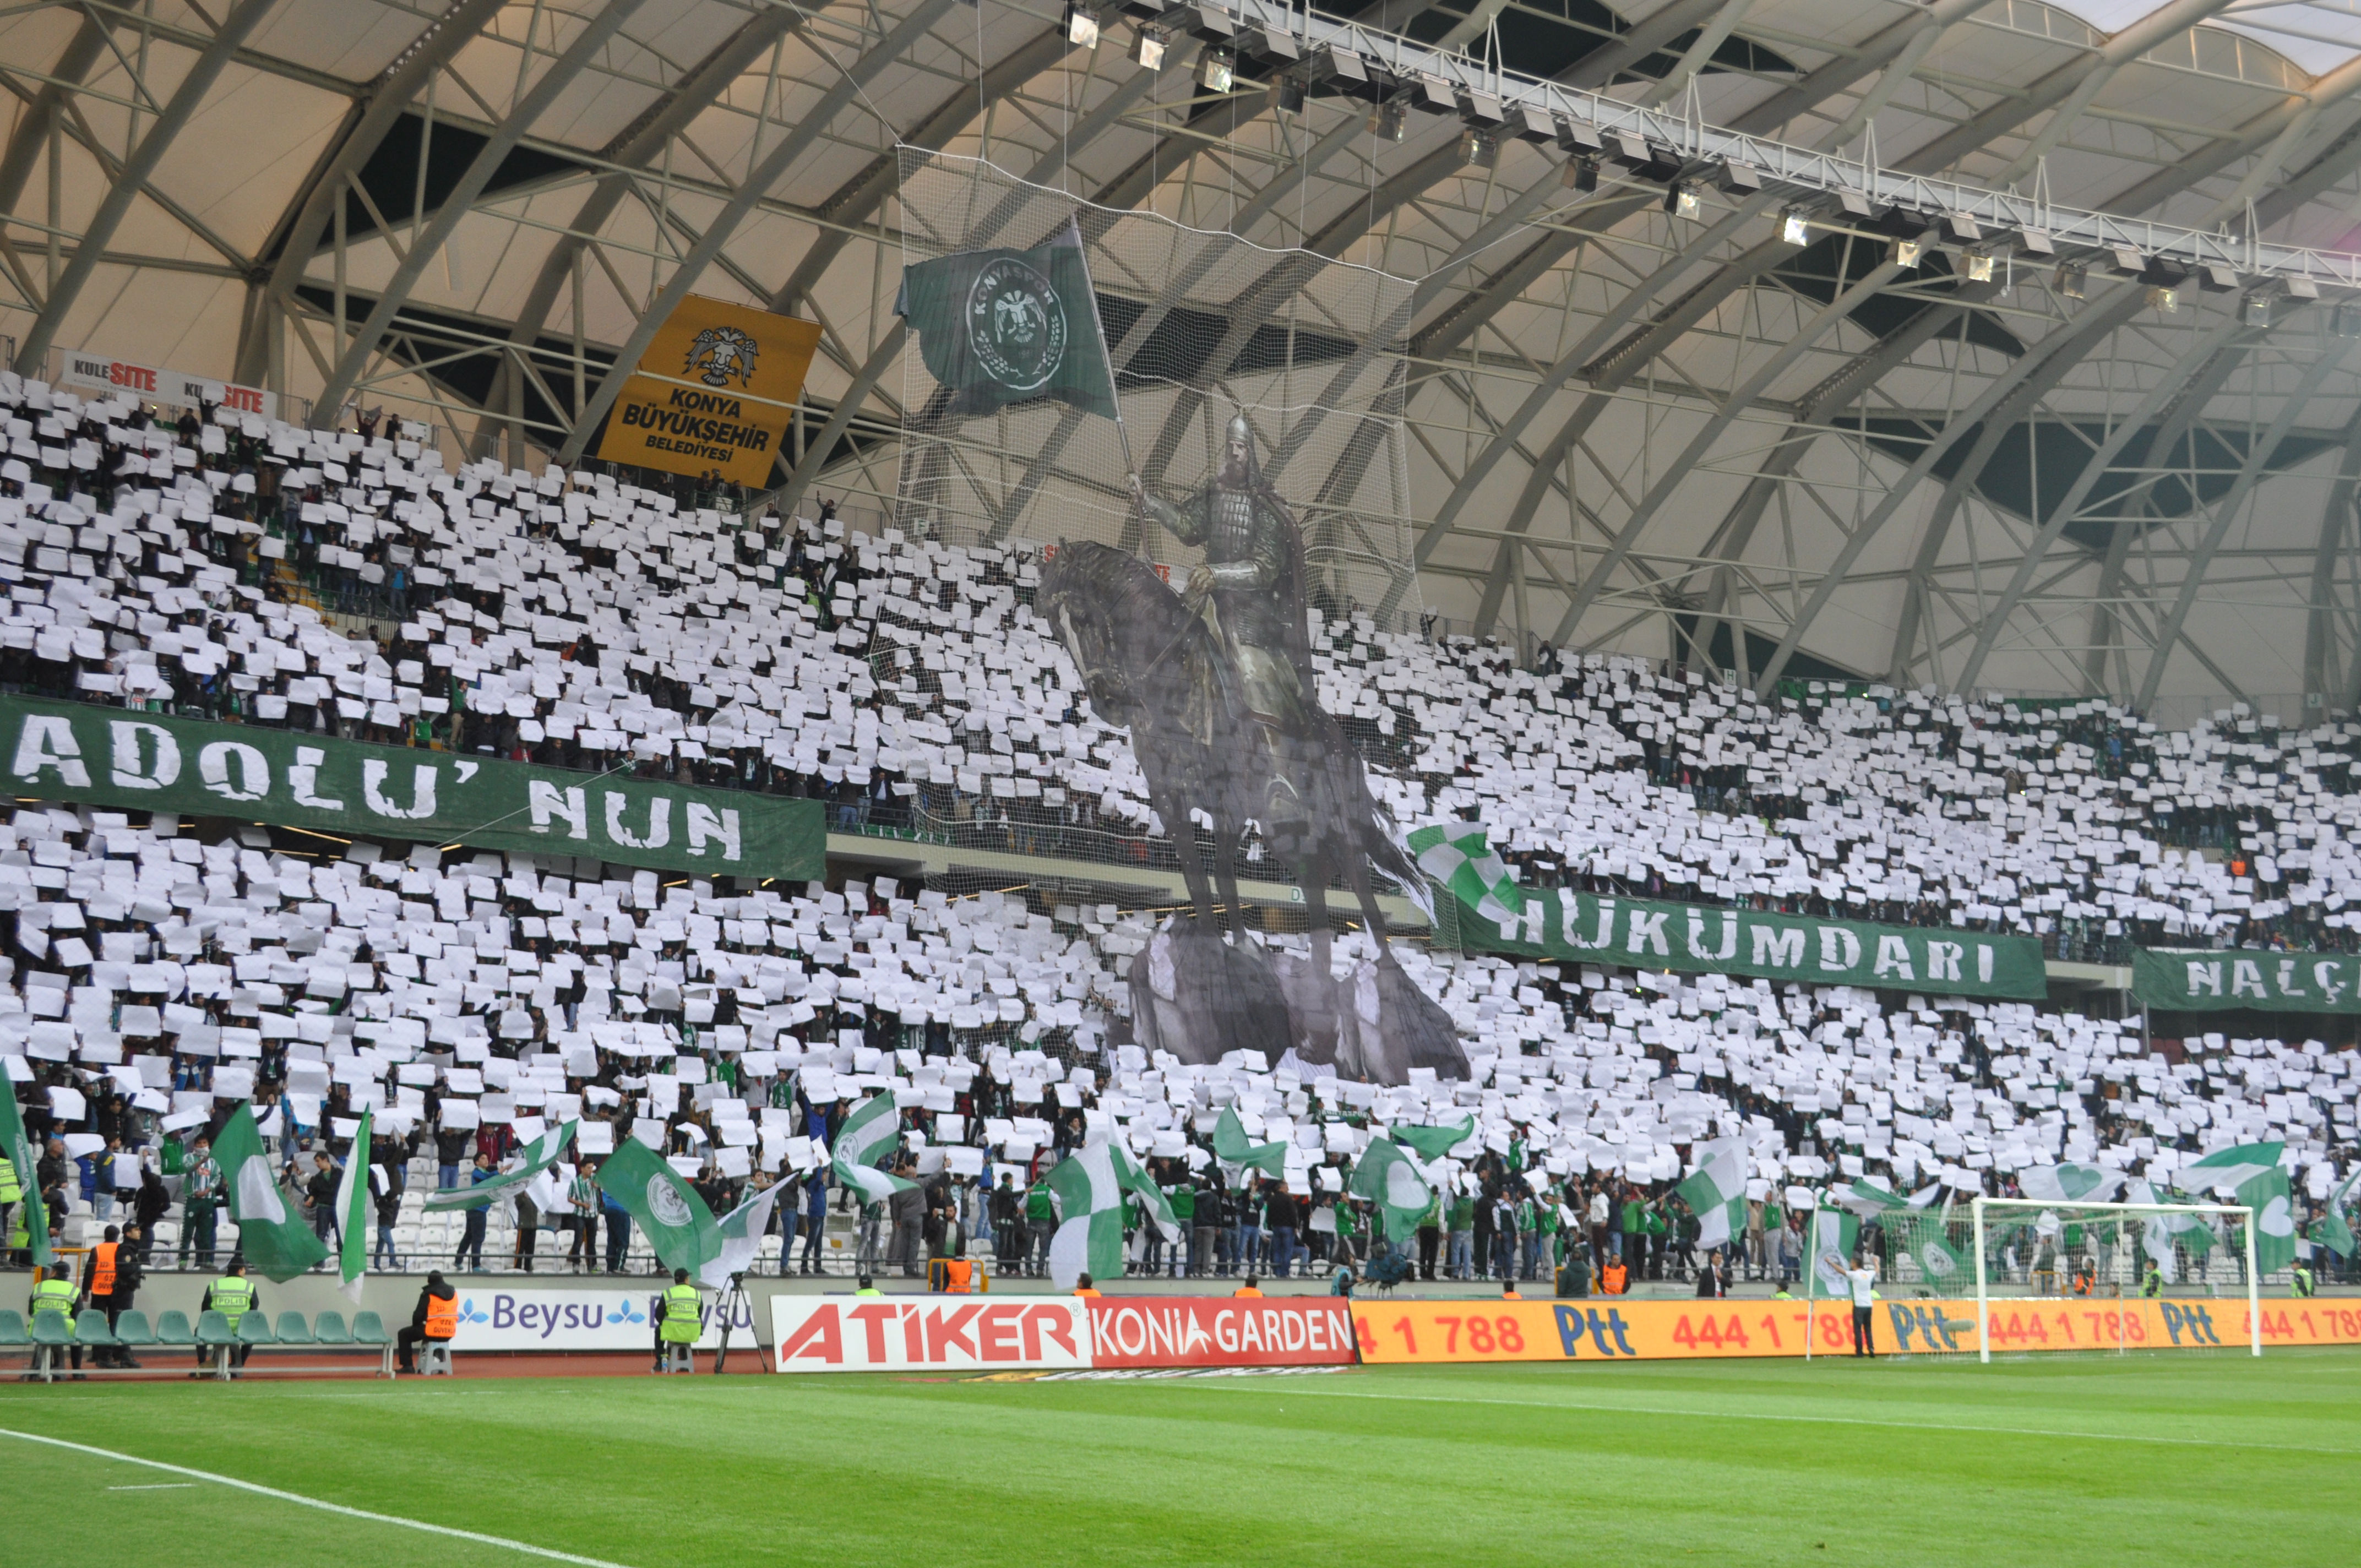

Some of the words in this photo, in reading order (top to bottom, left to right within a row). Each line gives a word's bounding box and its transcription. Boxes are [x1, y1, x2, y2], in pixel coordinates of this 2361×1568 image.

[975, 265, 1054, 314] KONYASPOR
[668, 388, 741, 418] KONYA
[622, 402, 770, 451] BÜYÜKŞEHİR
[645, 434, 735, 462] BELEDİYESİ
[529, 780, 741, 861] NUN
[493, 1294, 603, 1338] Beysu
[1214, 1308, 1353, 1353] GARDEN
[1392, 1316, 1418, 1354] 1
[1434, 1315, 1526, 1354] 788
[1552, 1304, 1636, 1356] Ptt
[1673, 1314, 1750, 1349] 444
[1760, 1314, 1782, 1348] 1
[1988, 1312, 2048, 1343] 444
[2057, 1312, 2076, 1343] 1
[2083, 1311, 2146, 1342] 788
[2159, 1302, 2221, 1344] Ptt
[2300, 1310, 2318, 1338] 1
